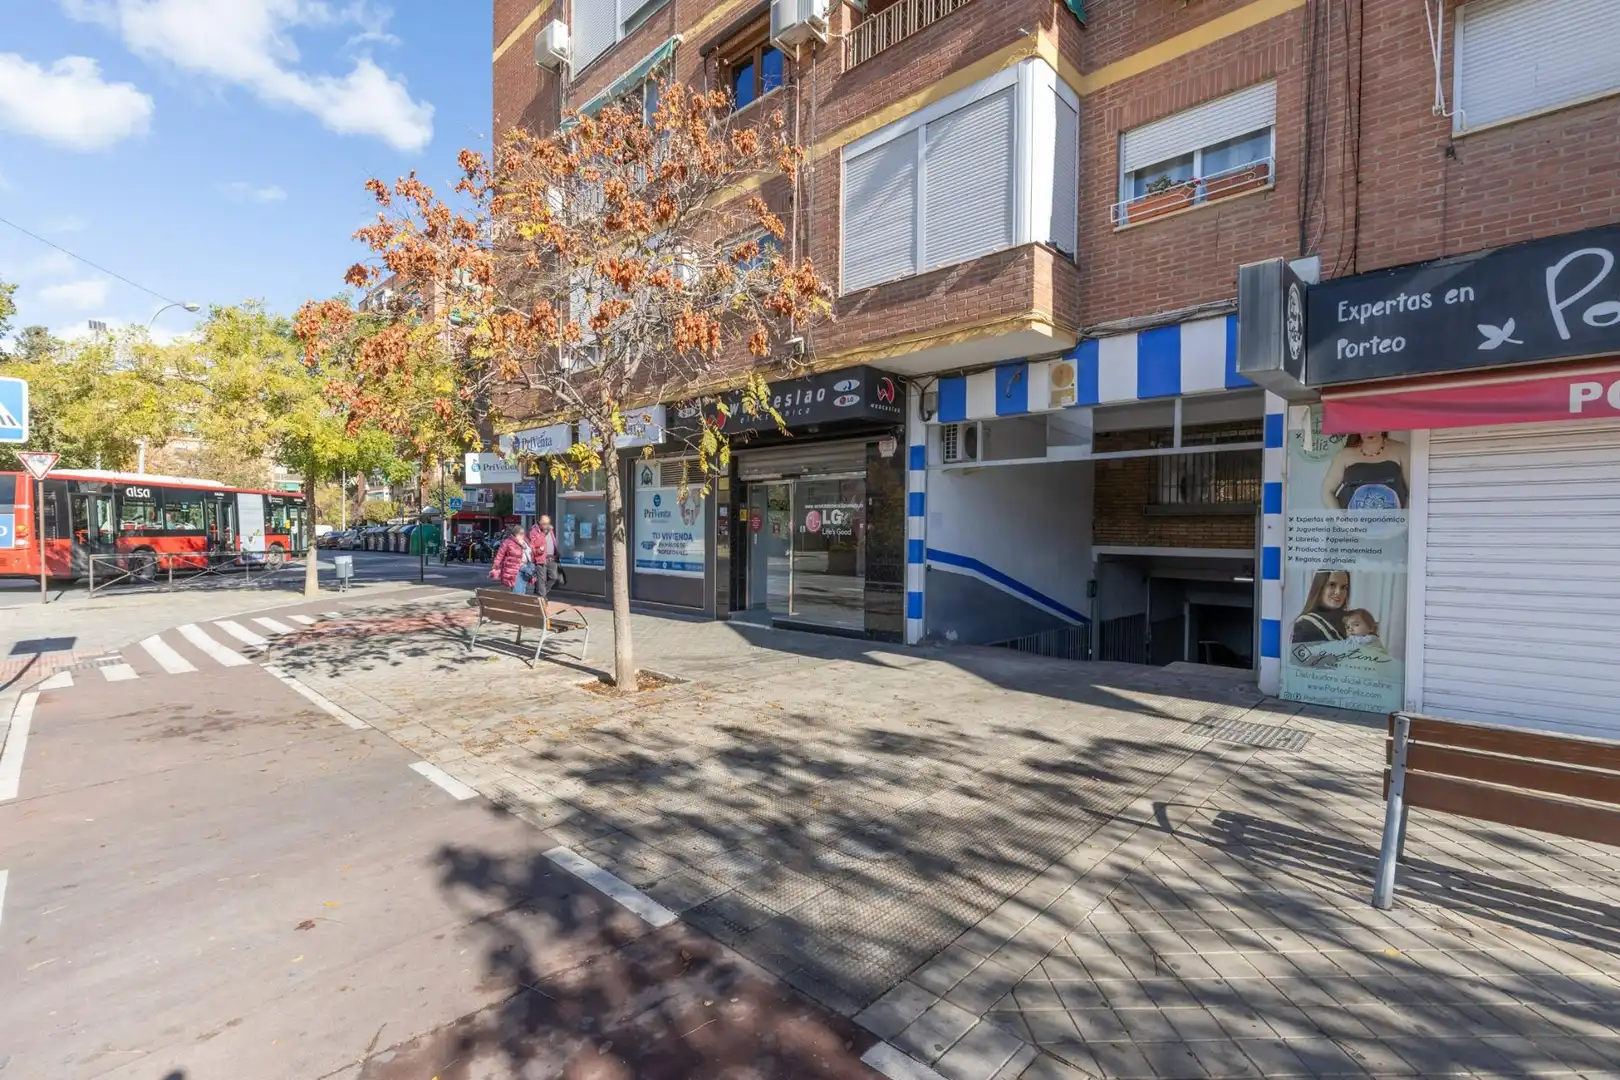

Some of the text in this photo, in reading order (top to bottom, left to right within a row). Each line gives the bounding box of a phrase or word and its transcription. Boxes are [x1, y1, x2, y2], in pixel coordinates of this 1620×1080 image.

[1338, 286, 1475, 325] Expertas en
[1337, 335, 1406, 360] Porteo
[126, 486, 150, 498] alsa
[644, 508, 671, 518] PriVenta
[822, 509, 842, 525] LG
[822, 528, 835, 537] Life's
